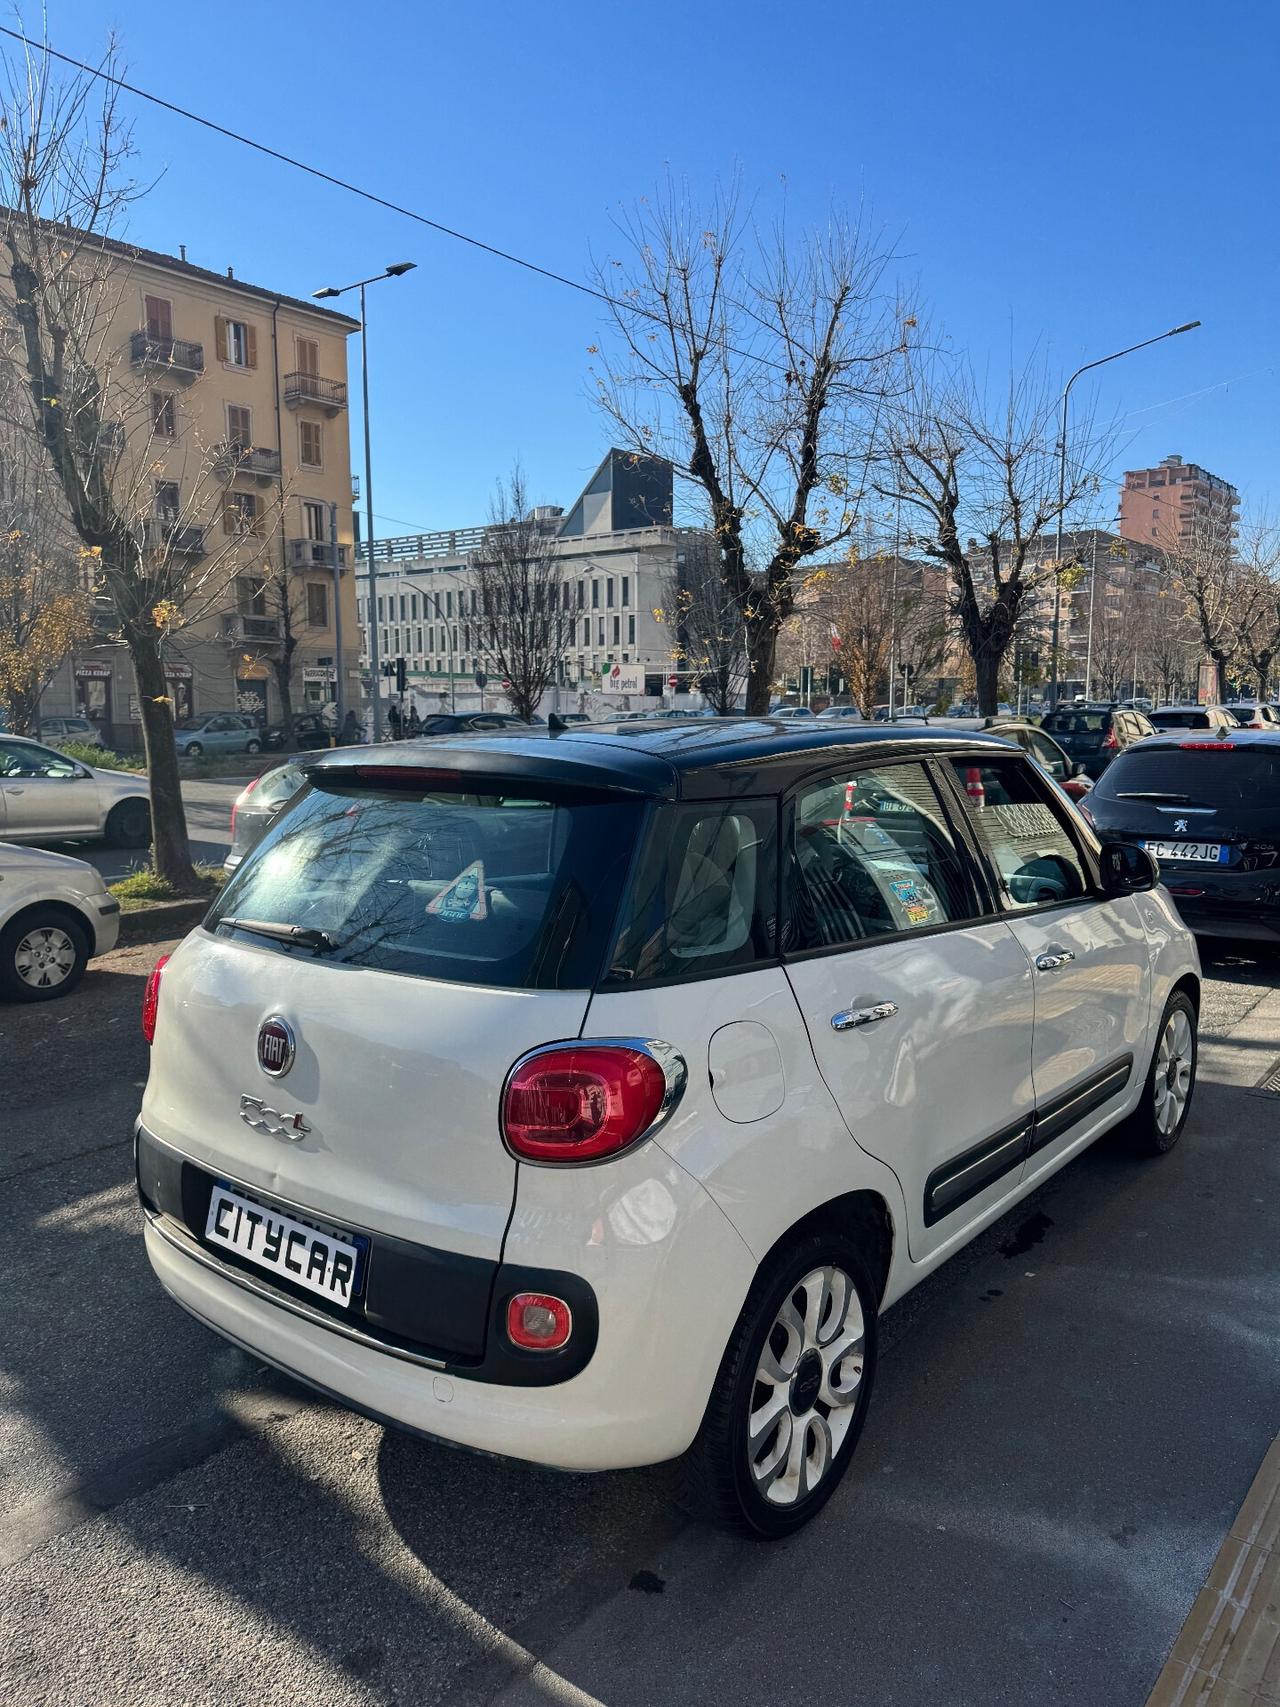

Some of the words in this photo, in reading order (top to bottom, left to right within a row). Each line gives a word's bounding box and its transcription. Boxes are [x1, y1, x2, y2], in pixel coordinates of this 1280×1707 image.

[75, 669, 92, 677] PIZZA
[610, 676, 620, 690] big
[621, 676, 638, 690] petrol
[1170, 843, 1219, 860] 442JG
[263, 1033, 286, 1063] FIAT
[214, 1198, 353, 1298] CITYCAR
